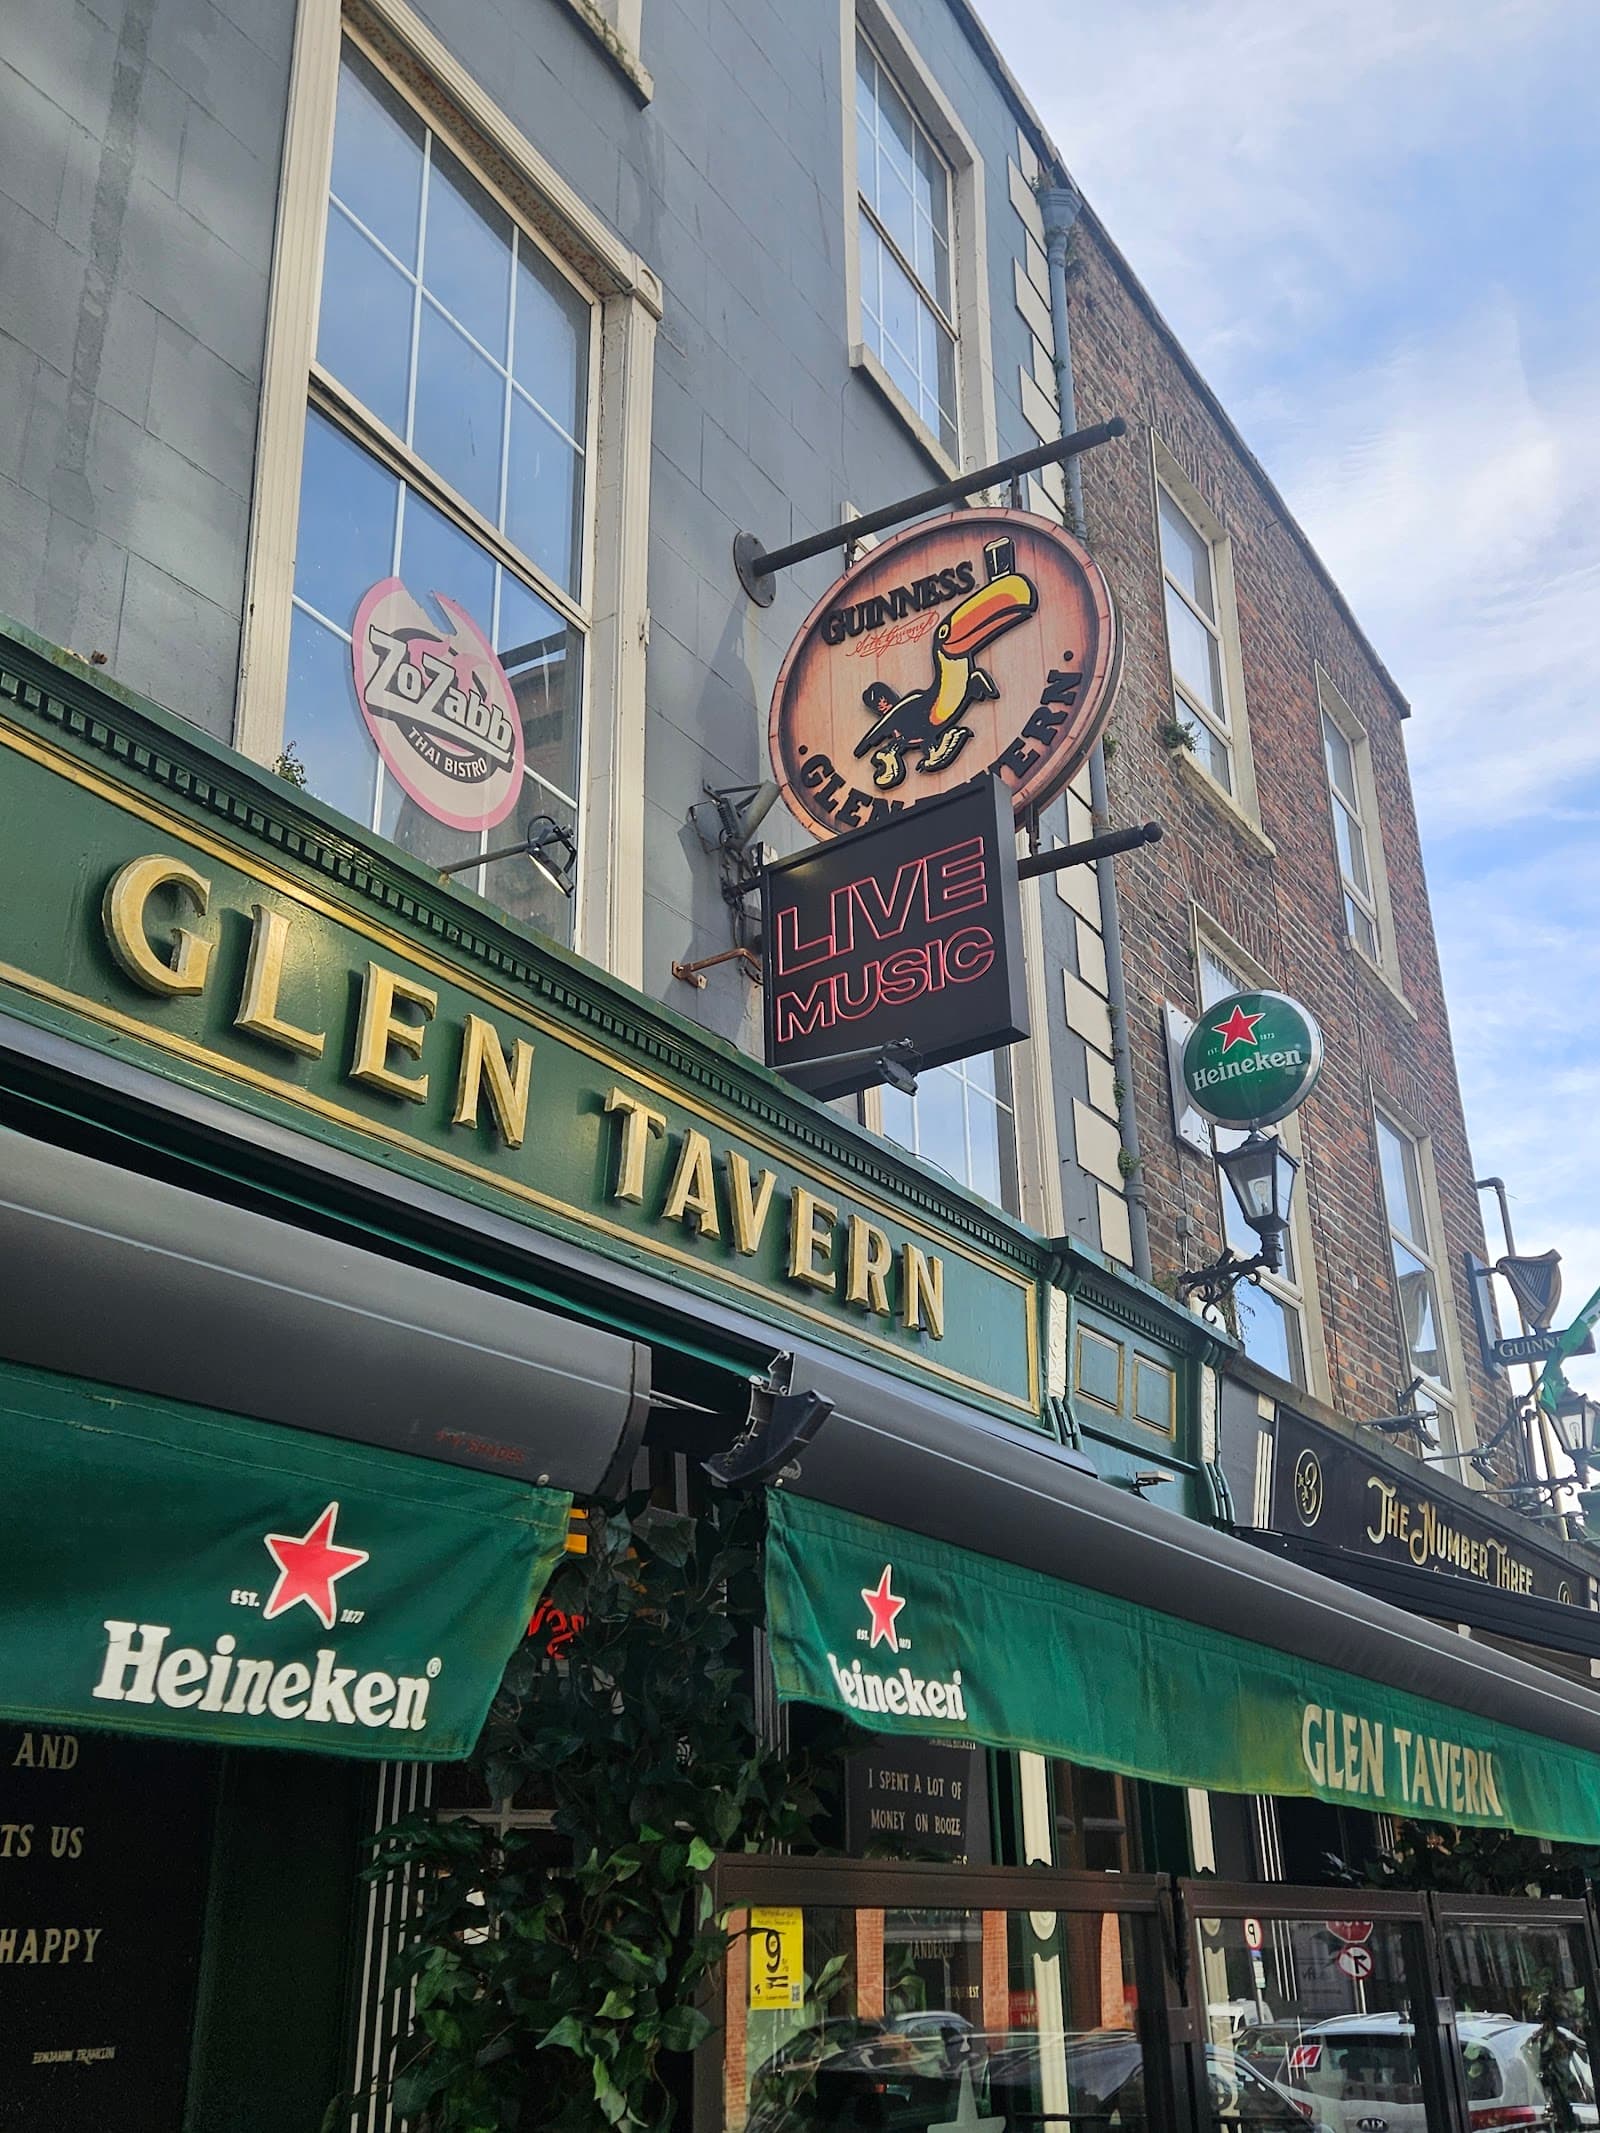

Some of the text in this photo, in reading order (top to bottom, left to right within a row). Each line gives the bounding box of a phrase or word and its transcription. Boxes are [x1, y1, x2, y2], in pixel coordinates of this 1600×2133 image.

[820, 560, 976, 646] GUINNESS
[365, 625, 514, 764] ZoZabb
[986, 669, 1083, 779] ERN
[408, 726, 487, 777] THAI BISTRO
[777, 836, 987, 976] LIVE
[777, 926, 995, 1043] MUSIC
[102, 853, 944, 1341] GLEN TAVERN
[1191, 1049, 1303, 1092] Heineken
[1499, 1336, 1561, 1358] GUINN
[92, 1619, 431, 1732] Heineken
[12, 1732, 79, 1770] AND
[880, 1770, 909, 1792] SPENT
[914, 1773, 922, 1793] A
[927, 1776, 944, 1797] LOT
[951, 1781, 962, 1800] OF
[1302, 1703, 1504, 1816] GLEN TAVERN
[50, 1826, 85, 1859] US
[871, 1808, 905, 1831] MONEY
[915, 1813, 929, 1832] ON
[0, 1928, 103, 1964] HAPPY
